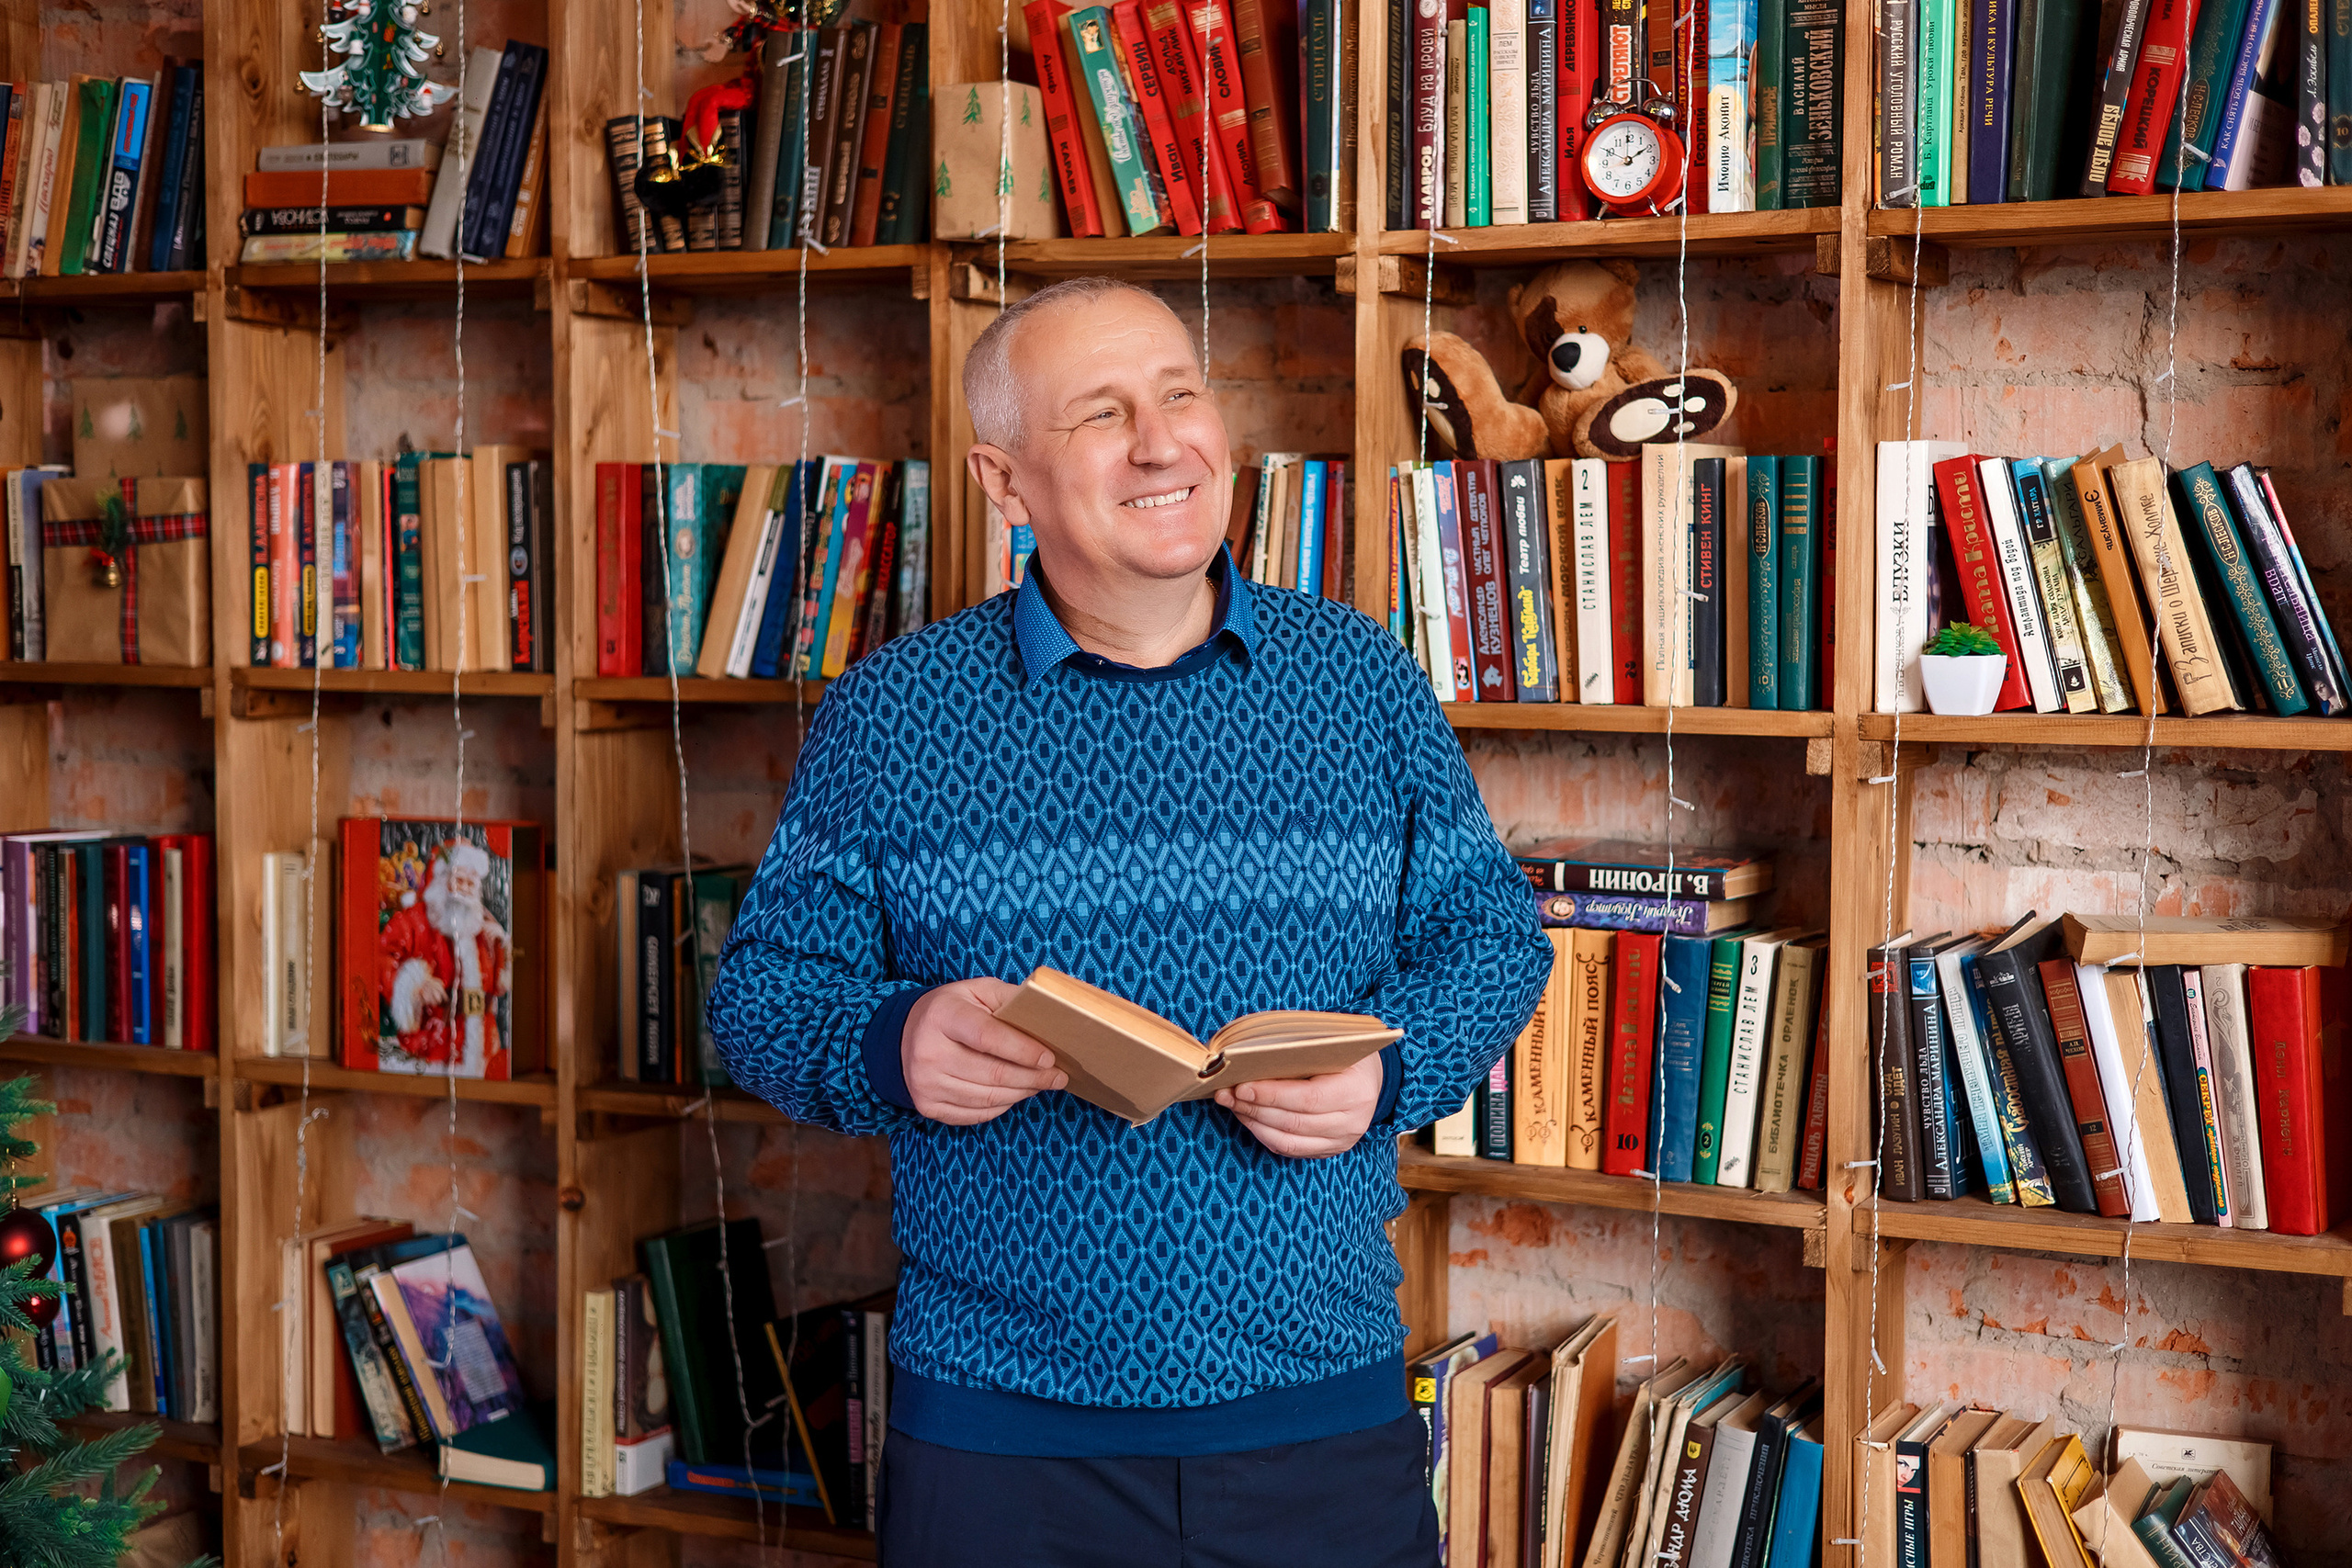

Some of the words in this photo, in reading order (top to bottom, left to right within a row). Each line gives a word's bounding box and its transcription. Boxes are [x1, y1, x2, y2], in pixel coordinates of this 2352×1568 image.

[1313, 12, 1326, 102] СТЕНДАЛЬ
[1693, 0, 1707, 70] МИРОНО
[1889, 19, 1906, 67] РУССКИЙ
[1926, 20, 1935, 53] любви
[1132, 40, 1159, 98] СЕРБИН
[1167, 27, 1193, 95] МИХАЙЛИК
[1611, 25, 1632, 103] СТРЕЛЯЮТ
[1925, 57, 1936, 89] Уроки
[1984, 39, 1996, 94] КУЛЬТУРА
[2115, 49, 2128, 72] АРМИЯ
[2237, 42, 2254, 76] БЫСТРО
[1531, 72, 1539, 98] ЛЬДА
[1792, 56, 1804, 116] ВАСИЛИЙ
[1804, 28, 1833, 140] ЗЕНЬКОВСКИЙ
[1889, 71, 1906, 136] УГОЛОВНЫЙ
[2232, 77, 2245, 100] БОЛЬ
[1043, 54, 1057, 94] Ариф
[1060, 141, 1077, 195] КАРАЕВ
[1531, 103, 1539, 153] ЧУВСТВО
[1717, 96, 1729, 141] Аконит
[1924, 96, 1935, 145] Картланд
[1958, 108, 1966, 133] Аркадий
[1984, 97, 1995, 126] РЕЧИ
[2132, 67, 2161, 149] КОРЕЦКИЙ
[2224, 101, 2240, 130] СНЯТЬ
[1564, 127, 1574, 159] Илья
[1693, 107, 1706, 167] Георгий
[1889, 141, 1904, 178] РОМАН
[2220, 130, 2233, 150] КАК
[1165, 142, 1185, 183] Иван
[1235, 139, 1255, 186] Леонид
[1717, 145, 1729, 192] Имение
[1467, 471, 1480, 523] ДЕТЕКТИВ
[1553, 476, 1566, 519] ВОЛК
[1581, 468, 1589, 491] 2
[1655, 454, 1666, 509] рукоделий
[1478, 492, 1489, 545] ЧЕГЛОКОВ
[1515, 496, 1528, 537] любви
[1579, 502, 1594, 527] ЛЕМ
[1700, 482, 1712, 524] КИНГ
[1953, 471, 1984, 563] Кристи
[2064, 481, 2086, 559] САЛЬГАРИ
[2085, 490, 2113, 551] Эммануэль
[2140, 492, 2165, 538] Холмсе
[1471, 526, 1483, 575] ЧАСТНЫЙ
[1657, 511, 1665, 554] женских
[2002, 538, 2018, 564] водой
[1482, 548, 1492, 575] ОЛЕГ
[1518, 538, 1531, 574] Театр
[1553, 524, 1570, 597] МОРСКОЙ
[1579, 535, 1597, 611] СТАНИСЛАВ
[1700, 530, 1713, 589] СТИВЕН
[1892, 521, 1909, 603] БЛУЗКИ
[2011, 566, 2023, 581] под
[1657, 557, 1666, 629] энциклопедия
[1792, 579, 1802, 626] философия
[1973, 566, 2001, 642] Агата
[2041, 566, 2056, 601] СОЛОМОНА
[2052, 573, 2064, 601] ТУМАНА
[2168, 599, 2183, 608] о
[1476, 585, 1490, 654] АЛЕКСАНДР
[1486, 581, 1501, 654] КУЗНЕЦОВ
[2014, 586, 2035, 637] Атлантида
[2049, 602, 2060, 620] ЦАРЯ
[2052, 621, 2064, 638] КОПИ
[2061, 605, 2071, 626] ЛЮДИ
[1656, 632, 1665, 671] Полная
[2169, 611, 2209, 671] Записки
[1565, 657, 1575, 684] ДЖЕК
[1624, 660, 1637, 678] 2
[1589, 868, 1682, 895] ПРОНИН
[1686, 874, 1709, 896] В.
[1585, 899, 1643, 923] Коултер
[1643, 903, 1693, 926] Кэтрин
[1585, 963, 1599, 1011] ПОЯС
[1749, 954, 1758, 975] 3
[1742, 986, 1758, 1012] ЛЕМ
[1946, 986, 1966, 1030] ПРИНЦА
[1529, 1010, 1547, 1115] КАМЕННЫЙ
[1733, 1019, 1755, 1095] СТАНИСЛАВ
[1917, 1046, 1928, 1076] ЛЬДА
[1922, 1002, 1942, 1081] МАРИНИНА
[1580, 1018, 1599, 1122] КАМЕННЫЙ
[1768, 1055, 1789, 1155] БИБЛИОТЕЧКА
[1782, 977, 1799, 1043] ОРЛЕНОК
[1883, 1073, 1894, 1097] СУД
[1892, 1066, 1905, 1097] ИДЕТ
[1956, 1032, 1985, 1111] ИСЧЕЗНУВШЕГО
[1810, 1072, 1828, 1128] ТАВЕРНЫ
[1920, 1078, 1932, 1130] ЧУВСТВО
[1995, 1047, 2029, 1133] Сладостная
[2198, 1073, 2215, 1127] СЕКРЕТ
[1489, 1093, 1507, 1147] ПОЛИНА
[1617, 1134, 1638, 1151] 10
[1702, 1135, 1710, 1145] 2
[1890, 1113, 1904, 1156] ЛАЗУТИН
[1932, 1086, 1949, 1171] АЛЕКСАНДРА
[1973, 1111, 1994, 1152] ТАЙНА
[2088, 1123, 2097, 1132] 12
[2278, 1089, 2293, 1156] Карнеги
[1803, 1132, 1821, 1179] РЫЦАРЬ
[2207, 1127, 2218, 1164] мрачного
[1894, 1159, 1905, 1186] ИВАН
[2212, 1165, 2225, 1209] подземелья
[1748, 1444, 1770, 1520] ПРИКЛЮЧЕНИЙ
[2151, 1462, 2186, 1472] Советская
[1674, 1468, 1697, 1522] ДЮМА
[1904, 1498, 1915, 1531] ИГРЫ
